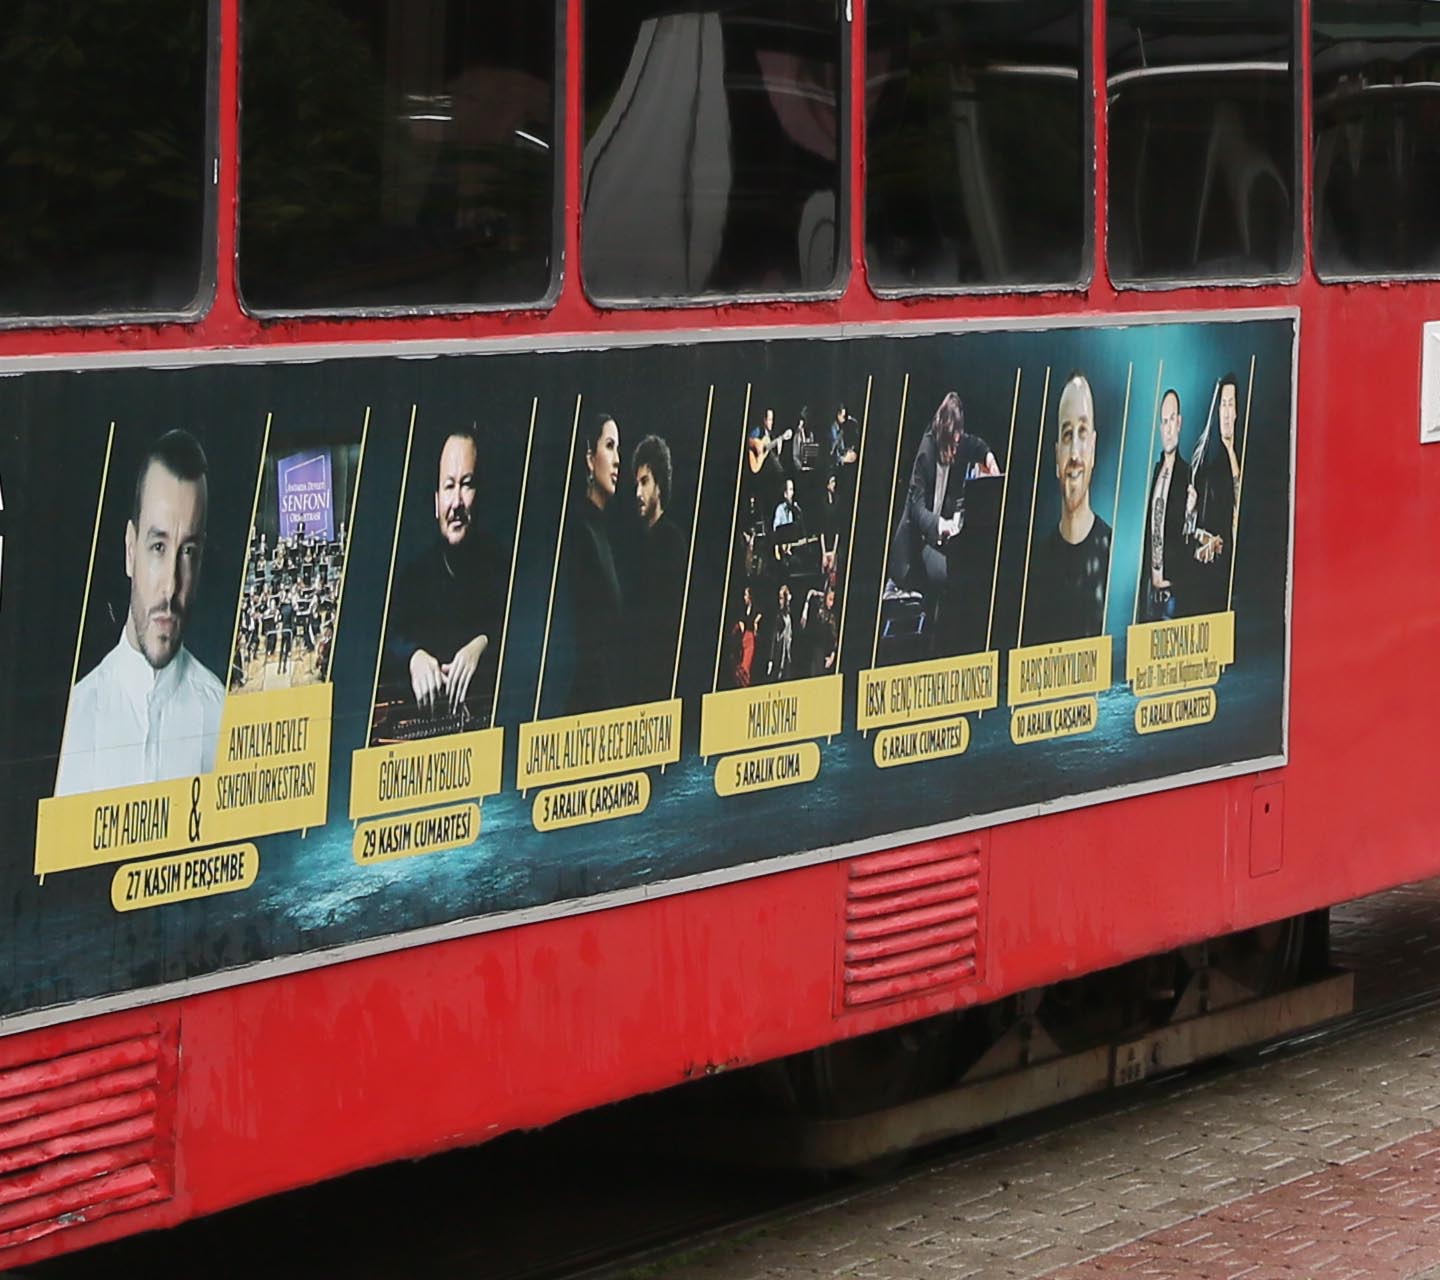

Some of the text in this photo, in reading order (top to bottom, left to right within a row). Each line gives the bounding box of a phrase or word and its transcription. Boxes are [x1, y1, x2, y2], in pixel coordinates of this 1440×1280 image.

[228, 716, 310, 762] ANTALYA DEVLET
[525, 732, 561, 775] JAMAL
[562, 721, 597, 770] ALİYEV
[598, 727, 607, 764] &
[607, 725, 624, 763] ECE
[882, 741, 888, 762] 6
[888, 735, 918, 760] ARALIK
[378, 747, 472, 802] GÖKHAN AYBULUS
[735, 753, 800, 788] 5 ARALIK CUMA
[93, 761, 316, 851] CEM ADRIAN & SENFONİ ORKESTRASI
[543, 780, 640, 823] 3 ARALIK ÇARŞAMBA
[362, 806, 471, 858] 29 KASIM CUMARTESİ
[126, 851, 246, 901] 27 KASIM PERŞEMBE
